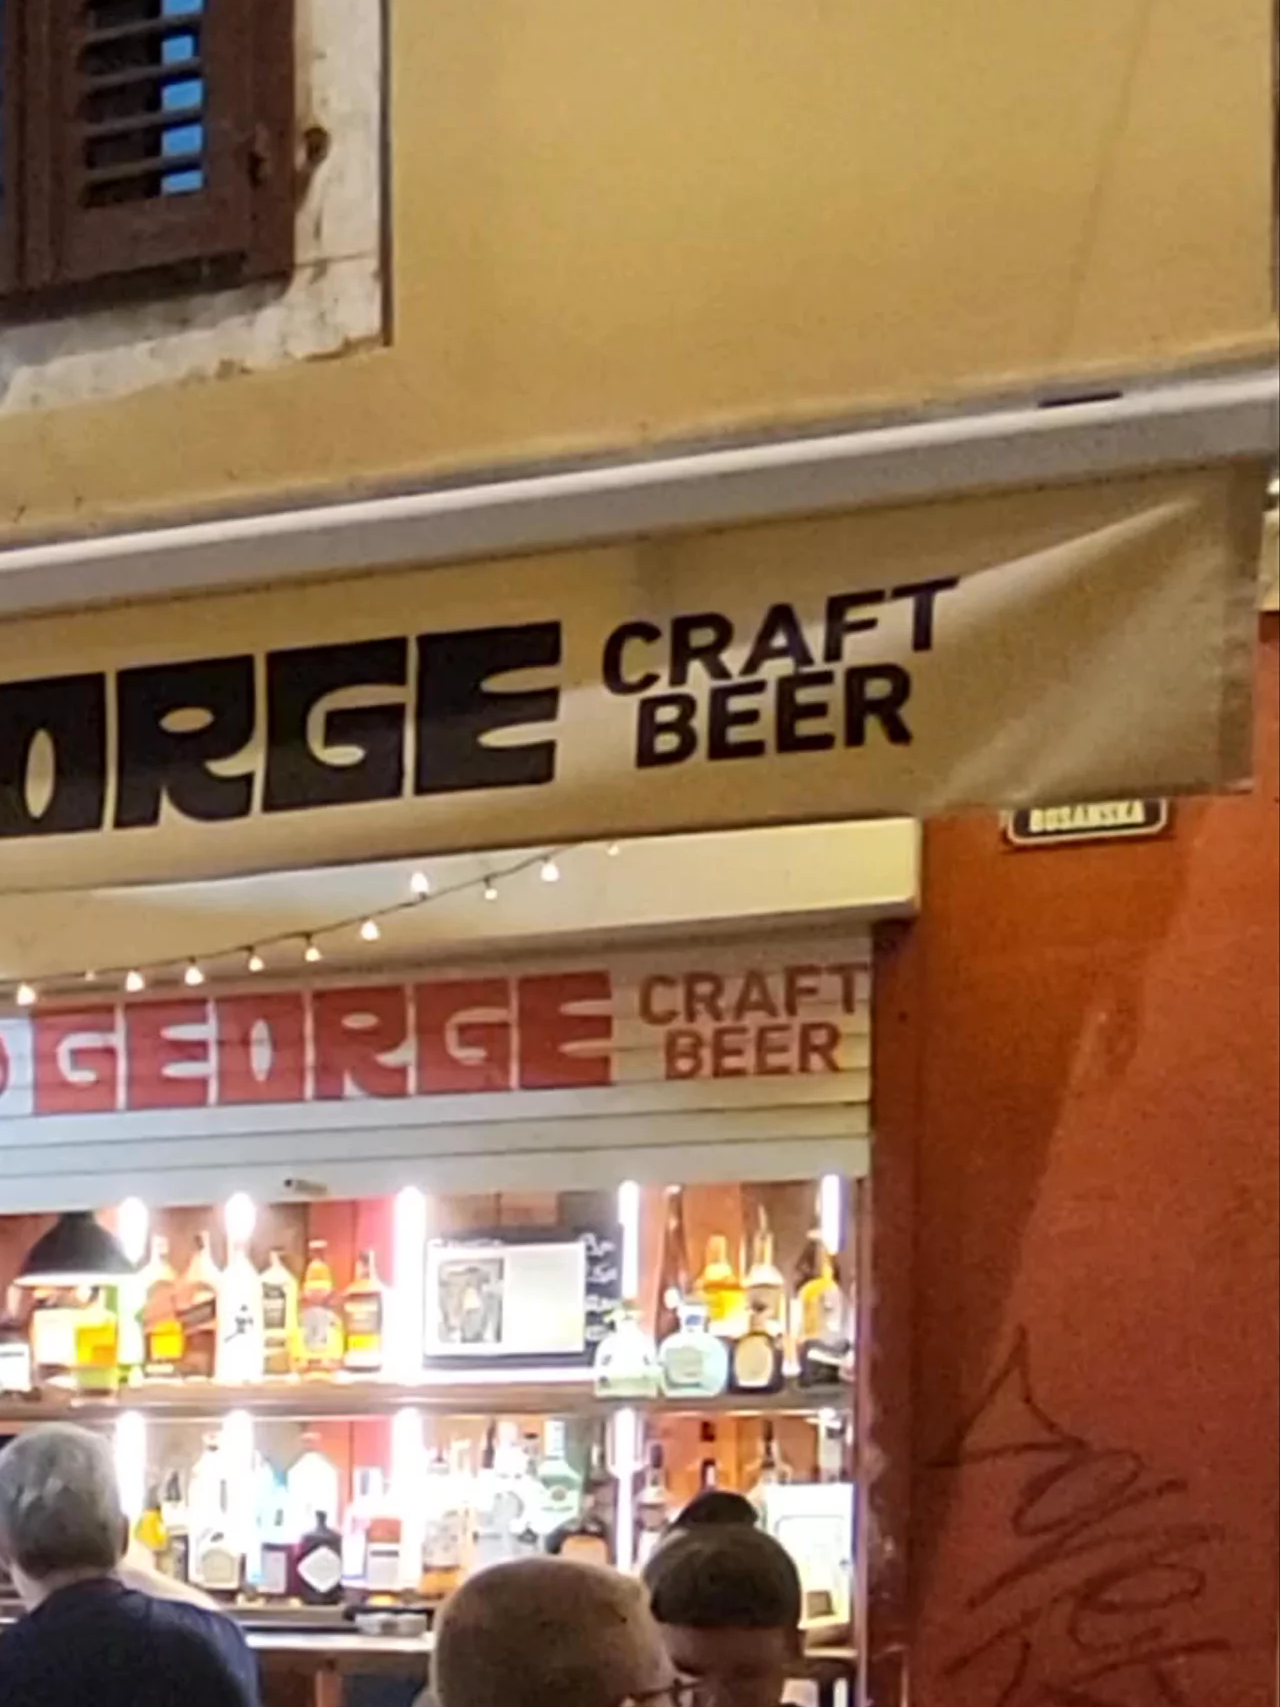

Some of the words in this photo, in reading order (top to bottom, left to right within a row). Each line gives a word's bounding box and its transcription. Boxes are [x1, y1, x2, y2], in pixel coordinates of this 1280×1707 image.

[602, 577, 960, 695] CRAFT
[635, 661, 913, 769] BEER
[31, 971, 614, 1115] GEORGE
[639, 962, 869, 1026] CRAFT
[665, 1020, 842, 1081] BEER
